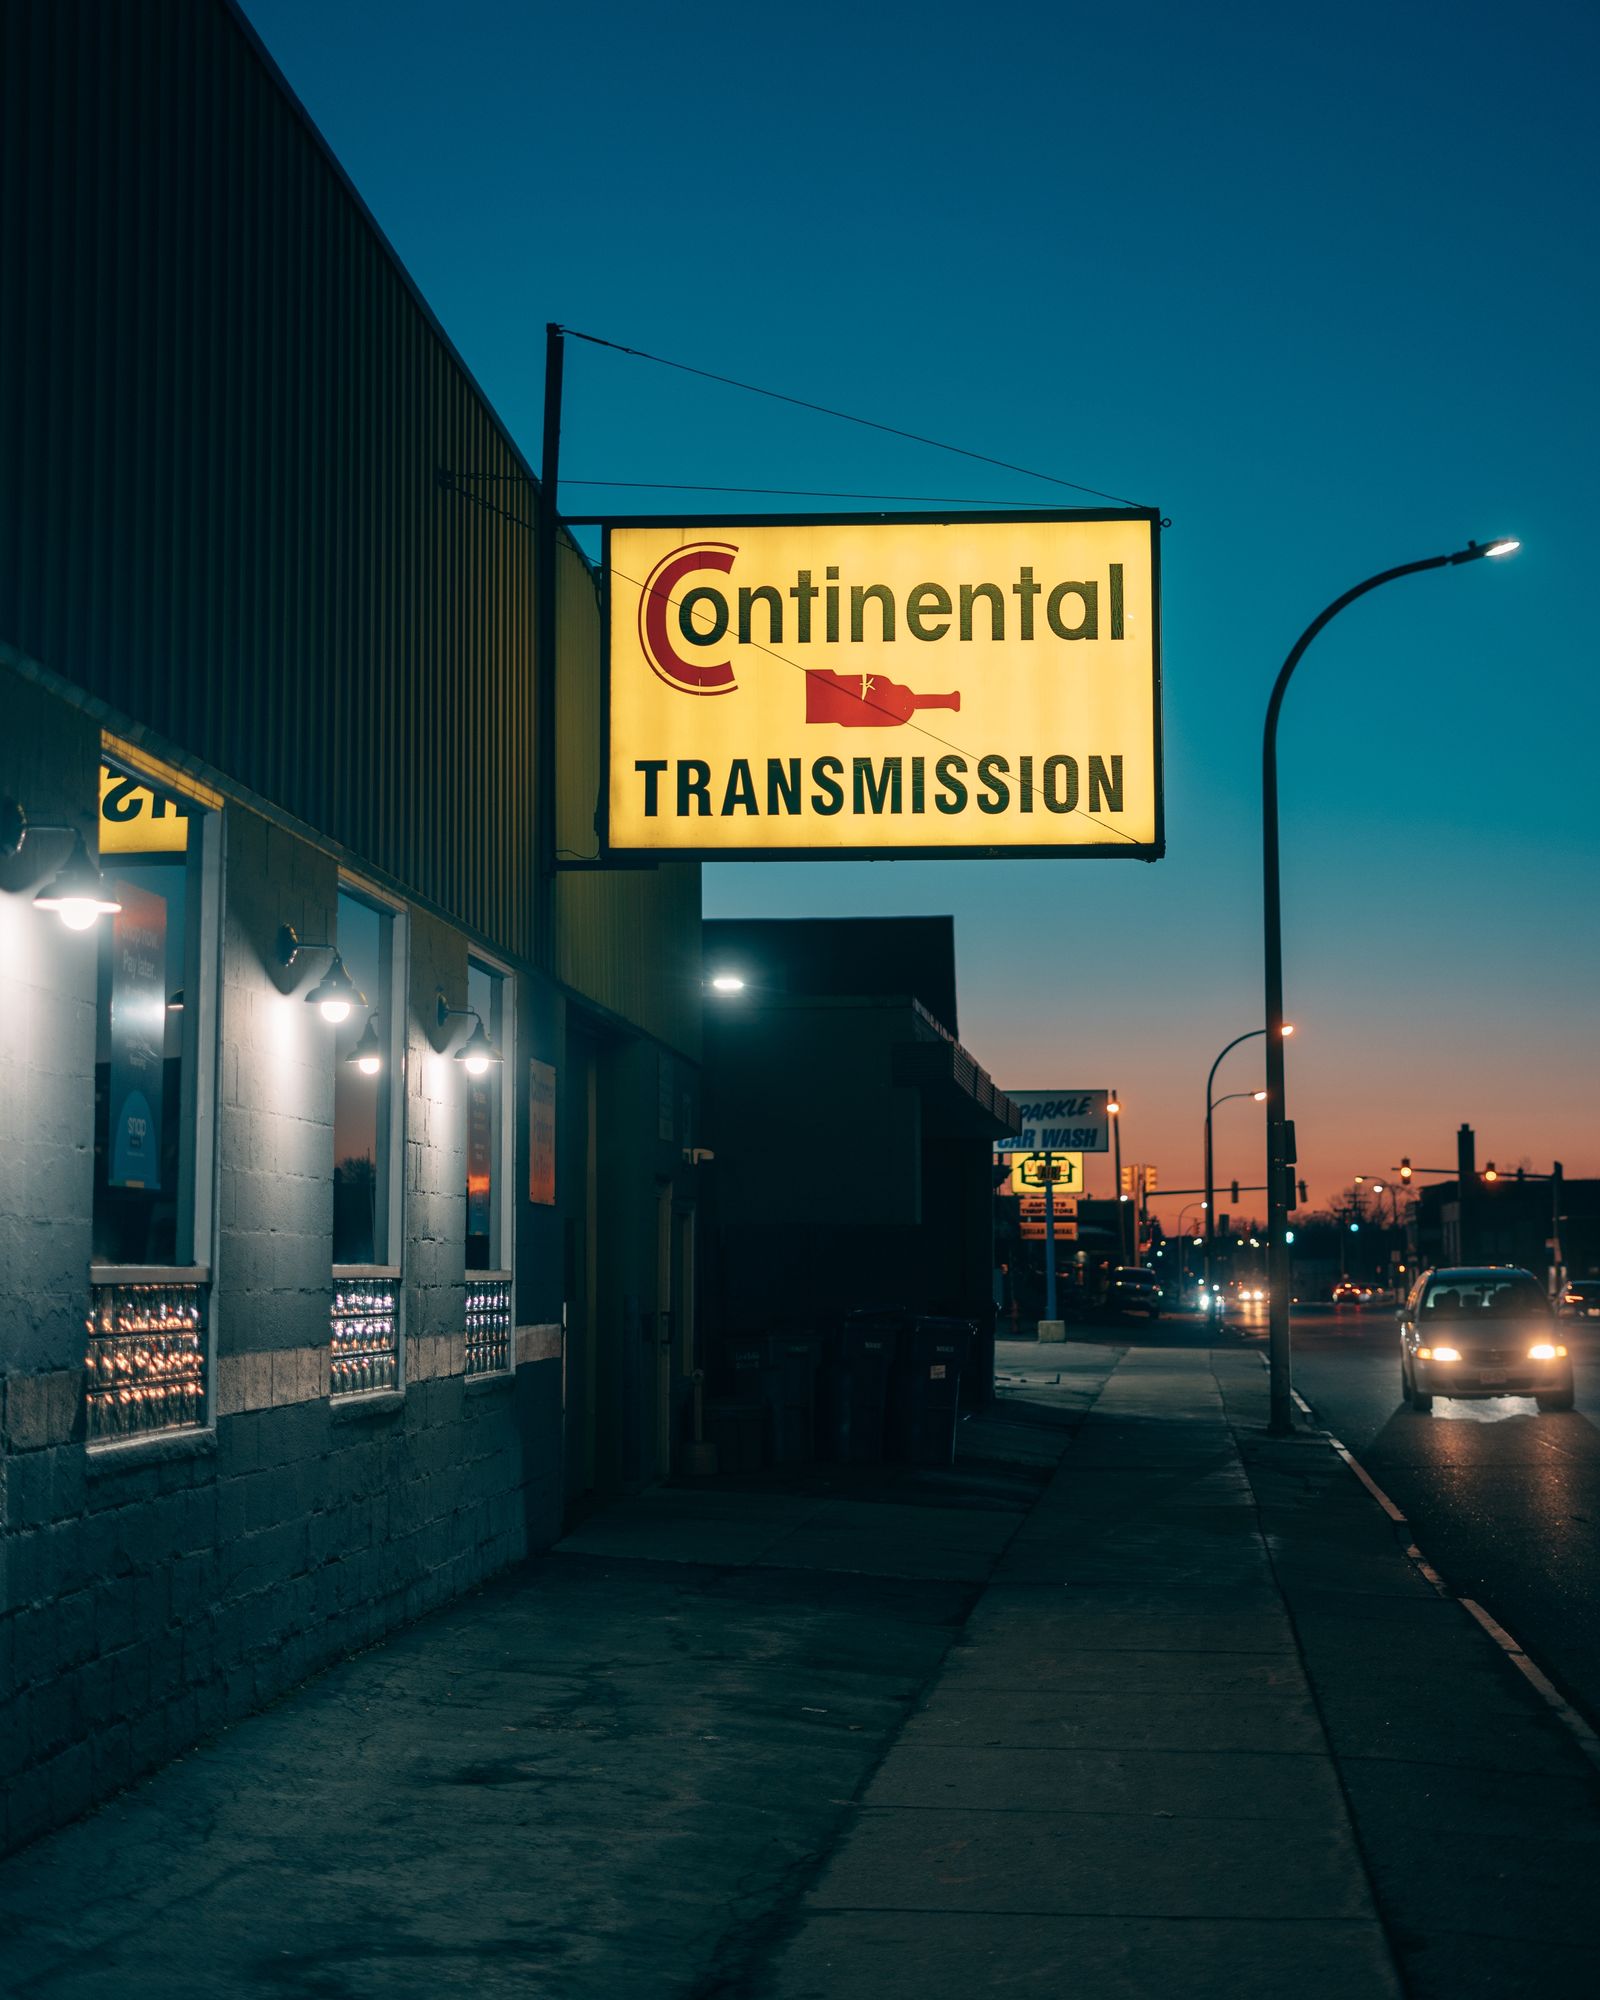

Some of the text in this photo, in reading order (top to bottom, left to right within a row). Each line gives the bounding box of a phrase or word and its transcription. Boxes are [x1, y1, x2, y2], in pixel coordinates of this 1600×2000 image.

[638, 541, 1124, 696] Continental
[635, 754, 1124, 817] TRANSMISSION
[123, 950, 137, 979] Pay
[1020, 1097, 1092, 1123] PARKLE
[1042, 1128, 1098, 1148] WASH
